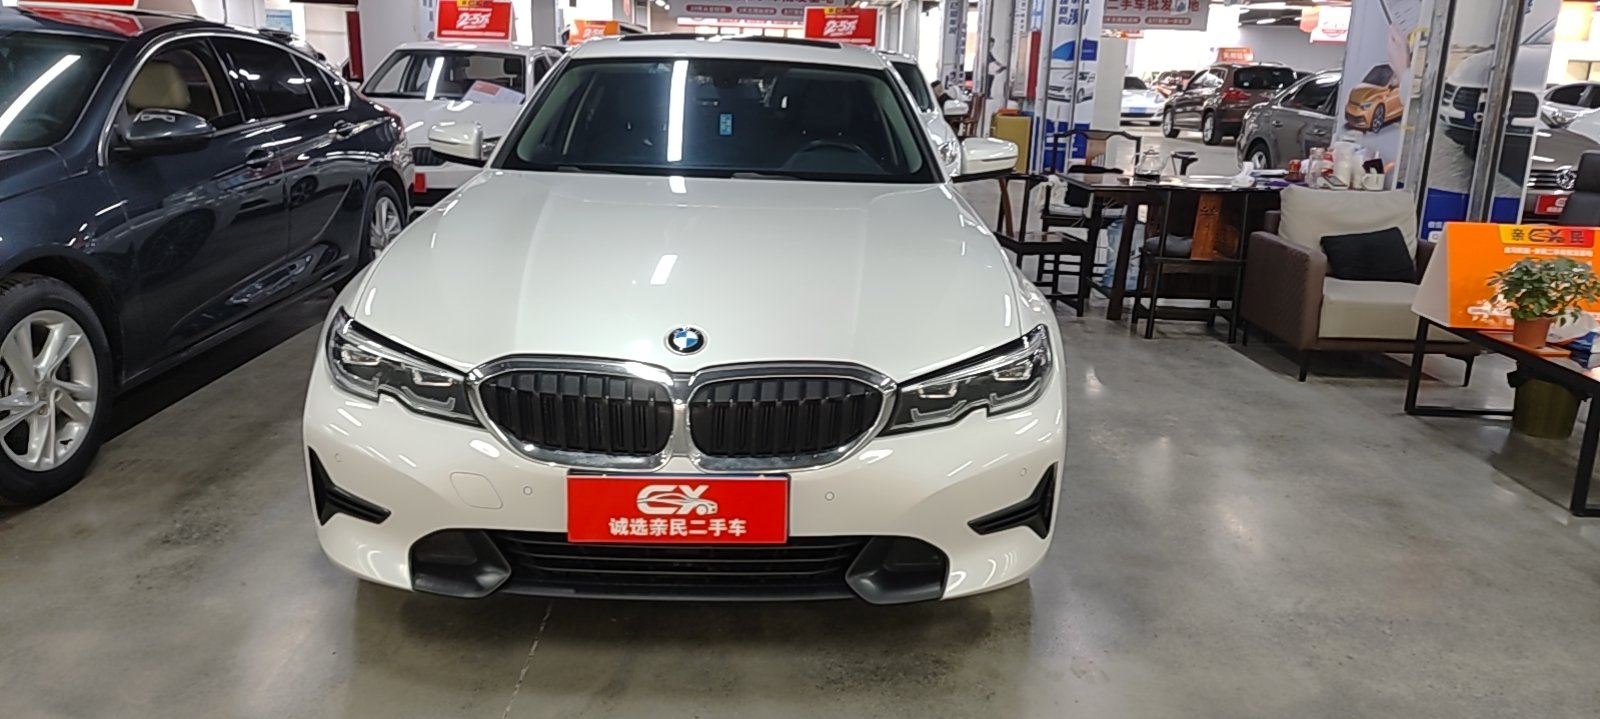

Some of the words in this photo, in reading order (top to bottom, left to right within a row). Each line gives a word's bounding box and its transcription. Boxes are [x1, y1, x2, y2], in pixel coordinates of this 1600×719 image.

[1105, 0, 1200, 12] 二手车批发地
[609, 517, 747, 537] 诚选亲民二手车
